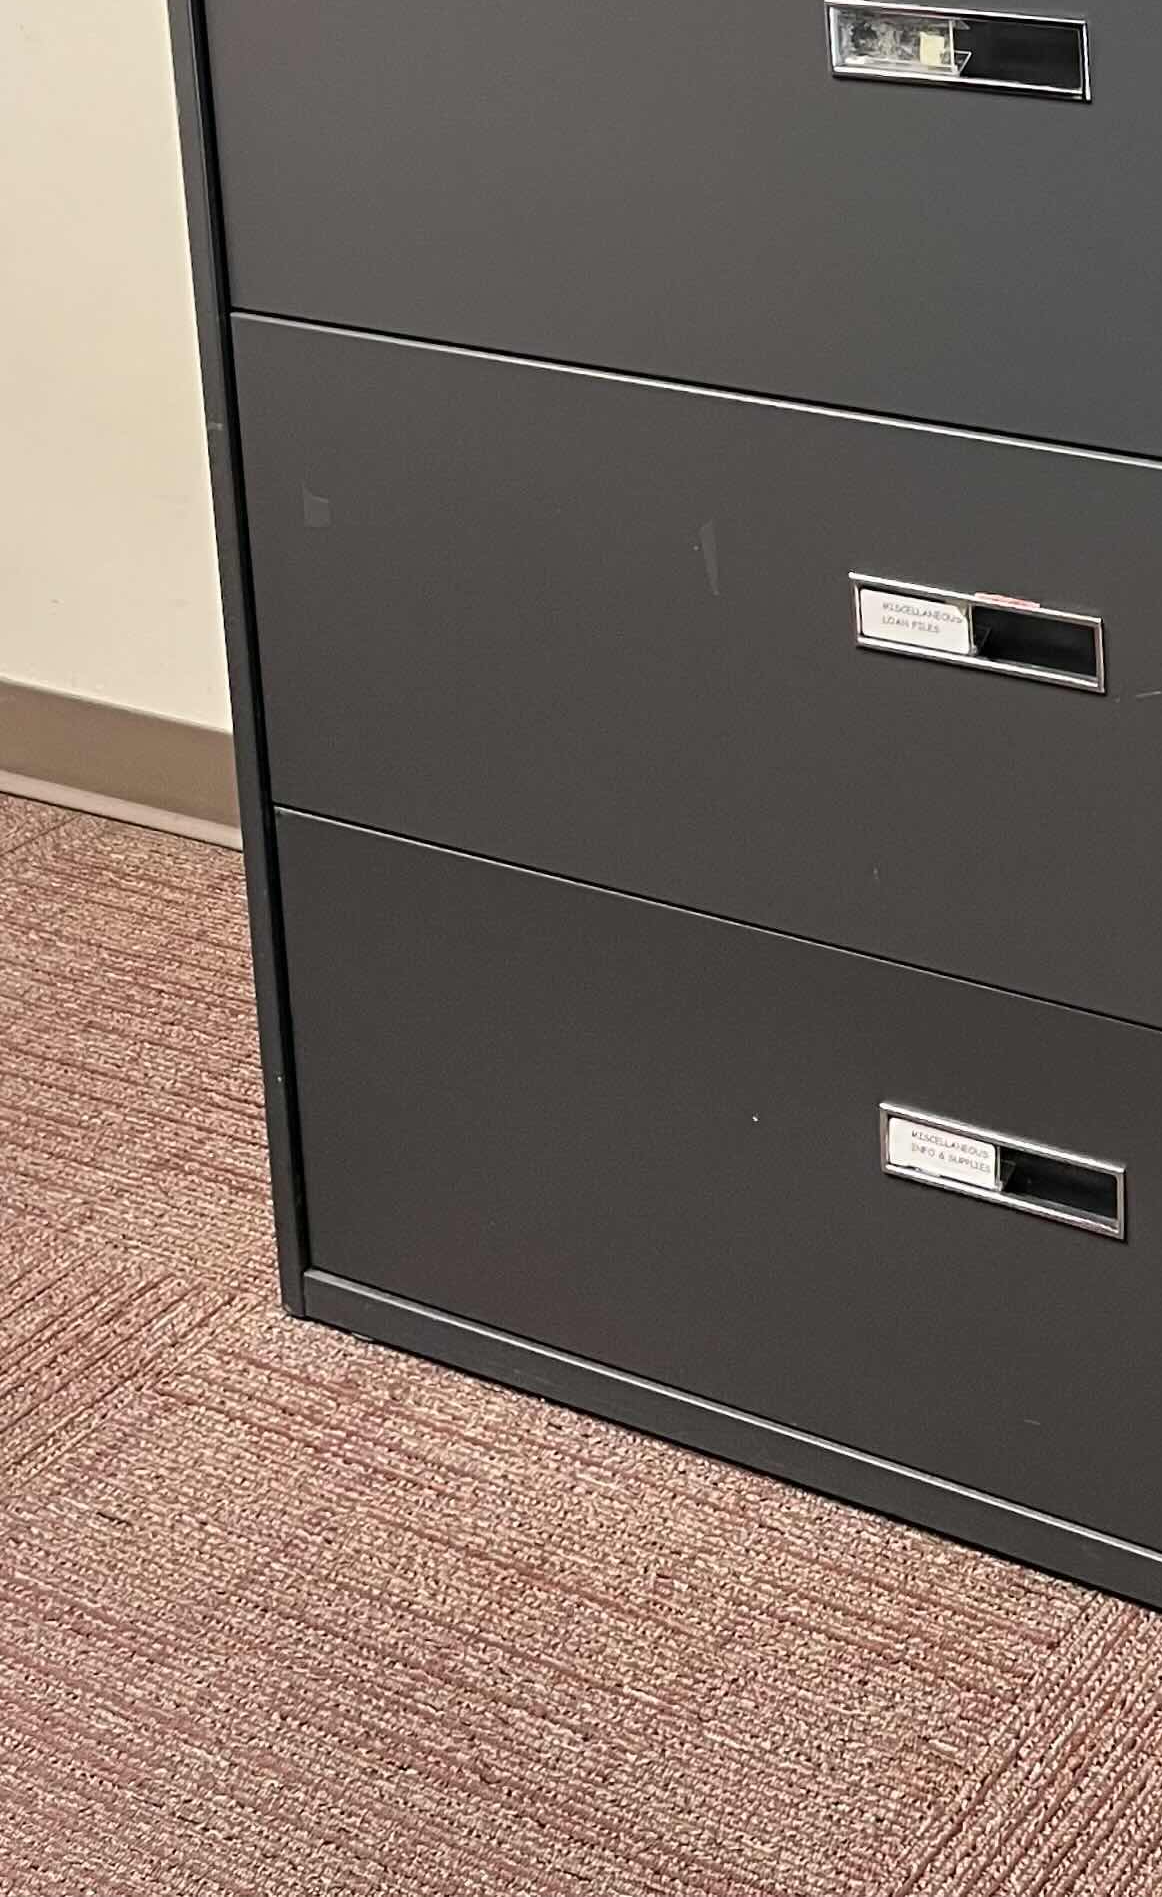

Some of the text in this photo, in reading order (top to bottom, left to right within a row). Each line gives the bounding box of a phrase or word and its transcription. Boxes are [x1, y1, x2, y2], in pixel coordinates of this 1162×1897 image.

[882, 602, 963, 624] MISCELLANEOUS
[882, 616, 940, 633] LOAN FILES
[911, 1129, 989, 1159] MISCELLANEOUS
[911, 1142, 936, 1157] INFO
[948, 1153, 991, 1173] SUPPLIES
